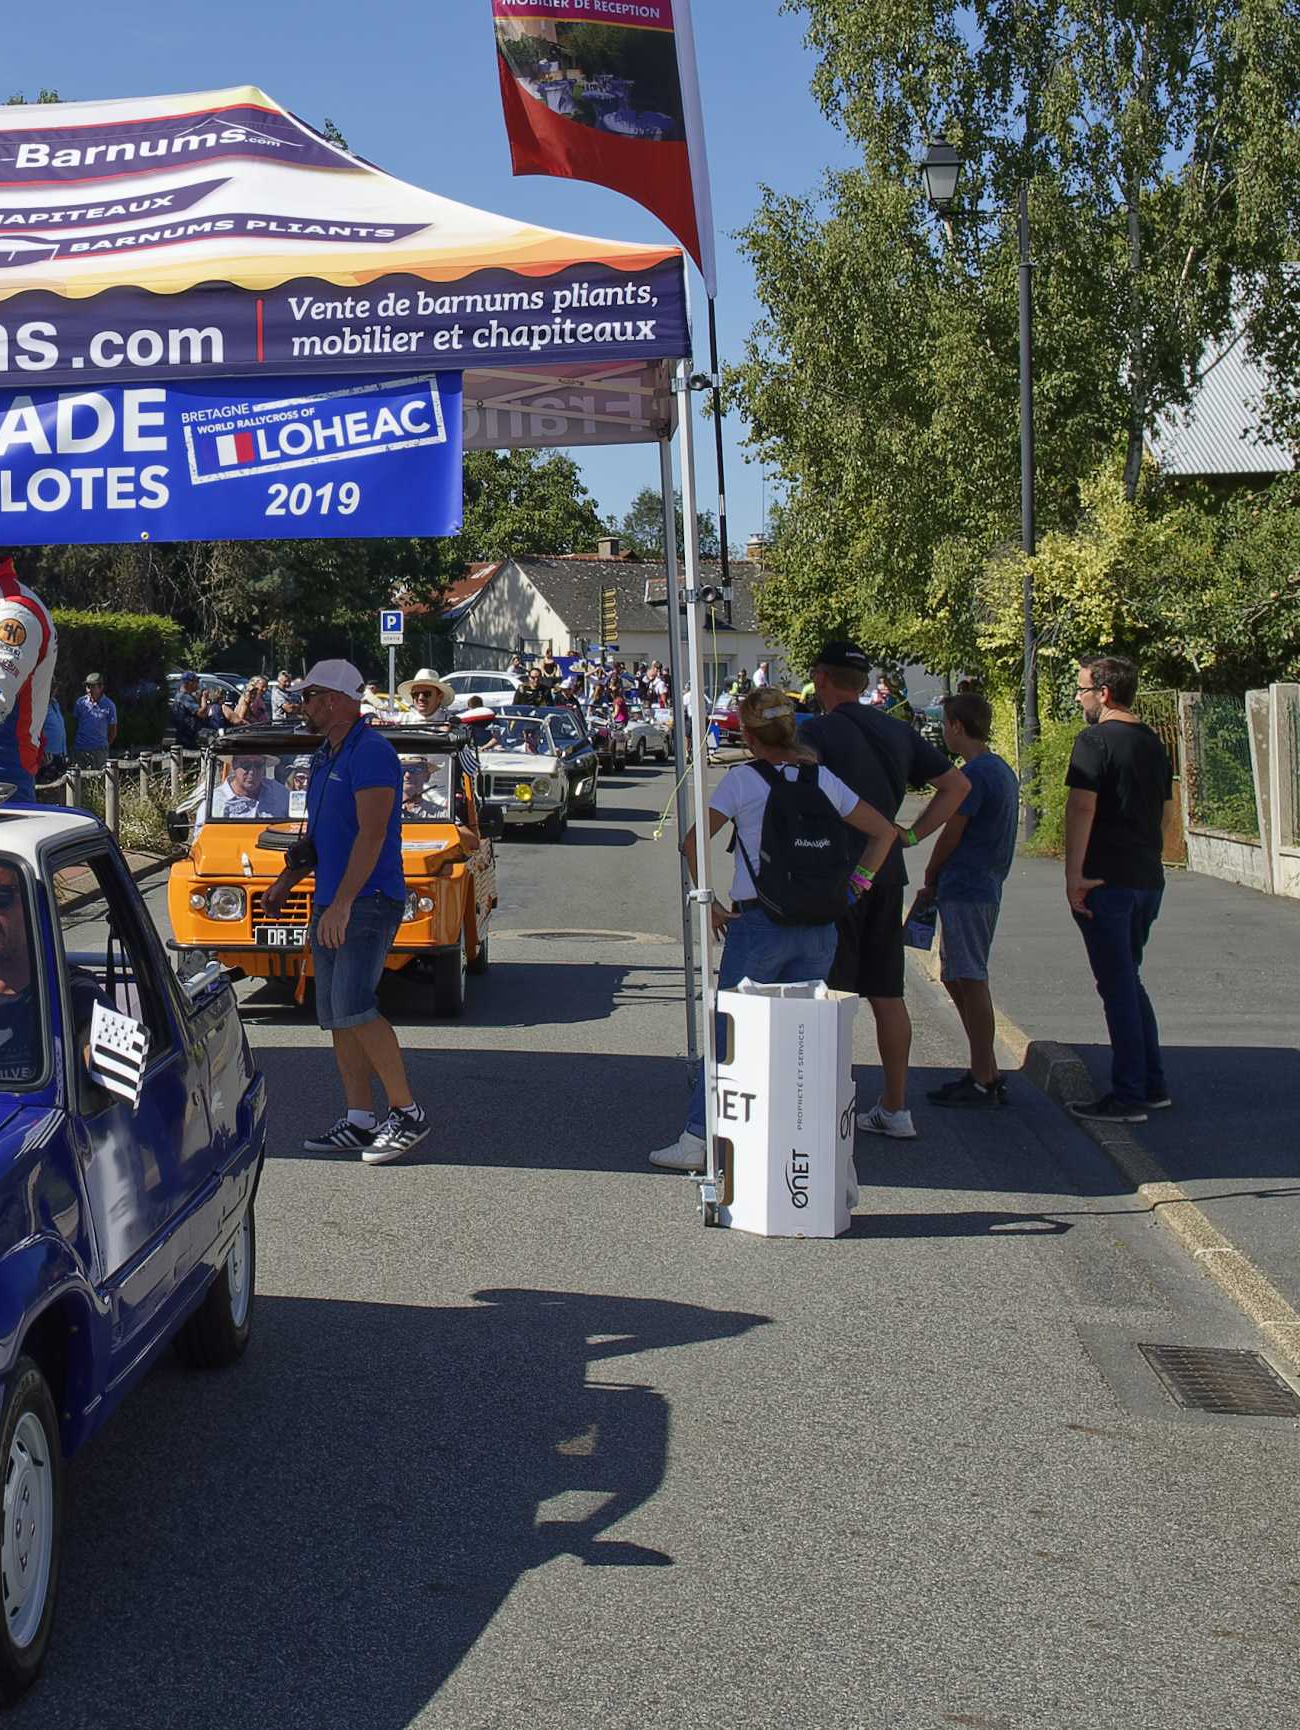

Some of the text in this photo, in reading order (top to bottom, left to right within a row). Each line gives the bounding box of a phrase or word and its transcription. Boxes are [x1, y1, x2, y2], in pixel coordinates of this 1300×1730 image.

[574, 0, 591, 9] DE
[69, 219, 396, 253] BARNUMS PLIANTS
[288, 282, 659, 321] Vente de barnums pliants,
[292, 317, 657, 356] mobilier et chapiteaux
[181, 403, 250, 423] BRETAGNE
[197, 407, 316, 434] WORLD RALLYCROSS OF
[256, 400, 430, 460] LOHEAC
[265, 481, 361, 516] 2019
[387, 615, 397, 629] P
